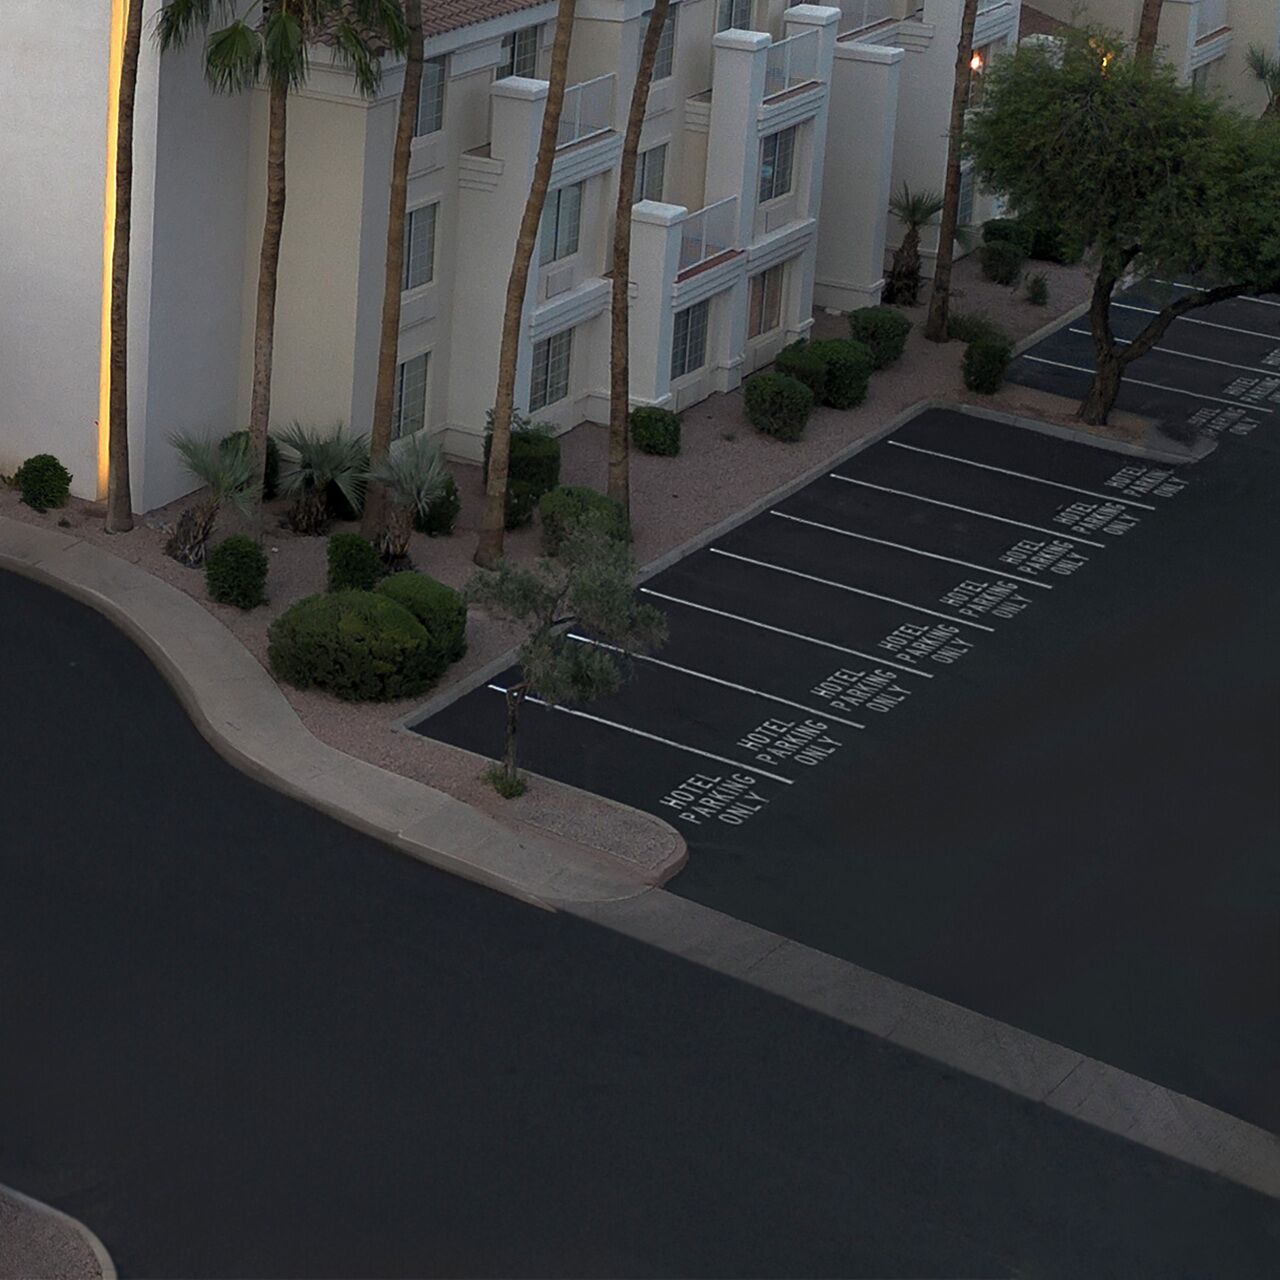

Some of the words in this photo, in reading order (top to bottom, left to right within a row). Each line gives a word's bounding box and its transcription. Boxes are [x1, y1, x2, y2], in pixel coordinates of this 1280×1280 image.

[1053, 502, 1098, 526] HOTEL
[998, 539, 1045, 565] HOTEL
[1017, 539, 1074, 575] PARKING
[1050, 551, 1090, 576] ONLY
[939, 580, 989, 607] HOTEL
[958, 580, 1018, 618] PARKING
[992, 593, 1032, 619] ONLY
[877, 623, 930, 652] HOTEL
[895, 623, 960, 664] PARKING
[931, 636, 974, 665] ONLY
[810, 668, 866, 699] HOTEL
[829, 669, 898, 712] PARKING
[865, 683, 912, 713] ONLY
[737, 718, 795, 751] HOTEL
[755, 719, 828, 766] PARKING
[793, 735, 842, 766] ONLY
[659, 773, 722, 809] HOTEL
[678, 773, 756, 825] PARKING
[718, 791, 770, 826] ONLY
